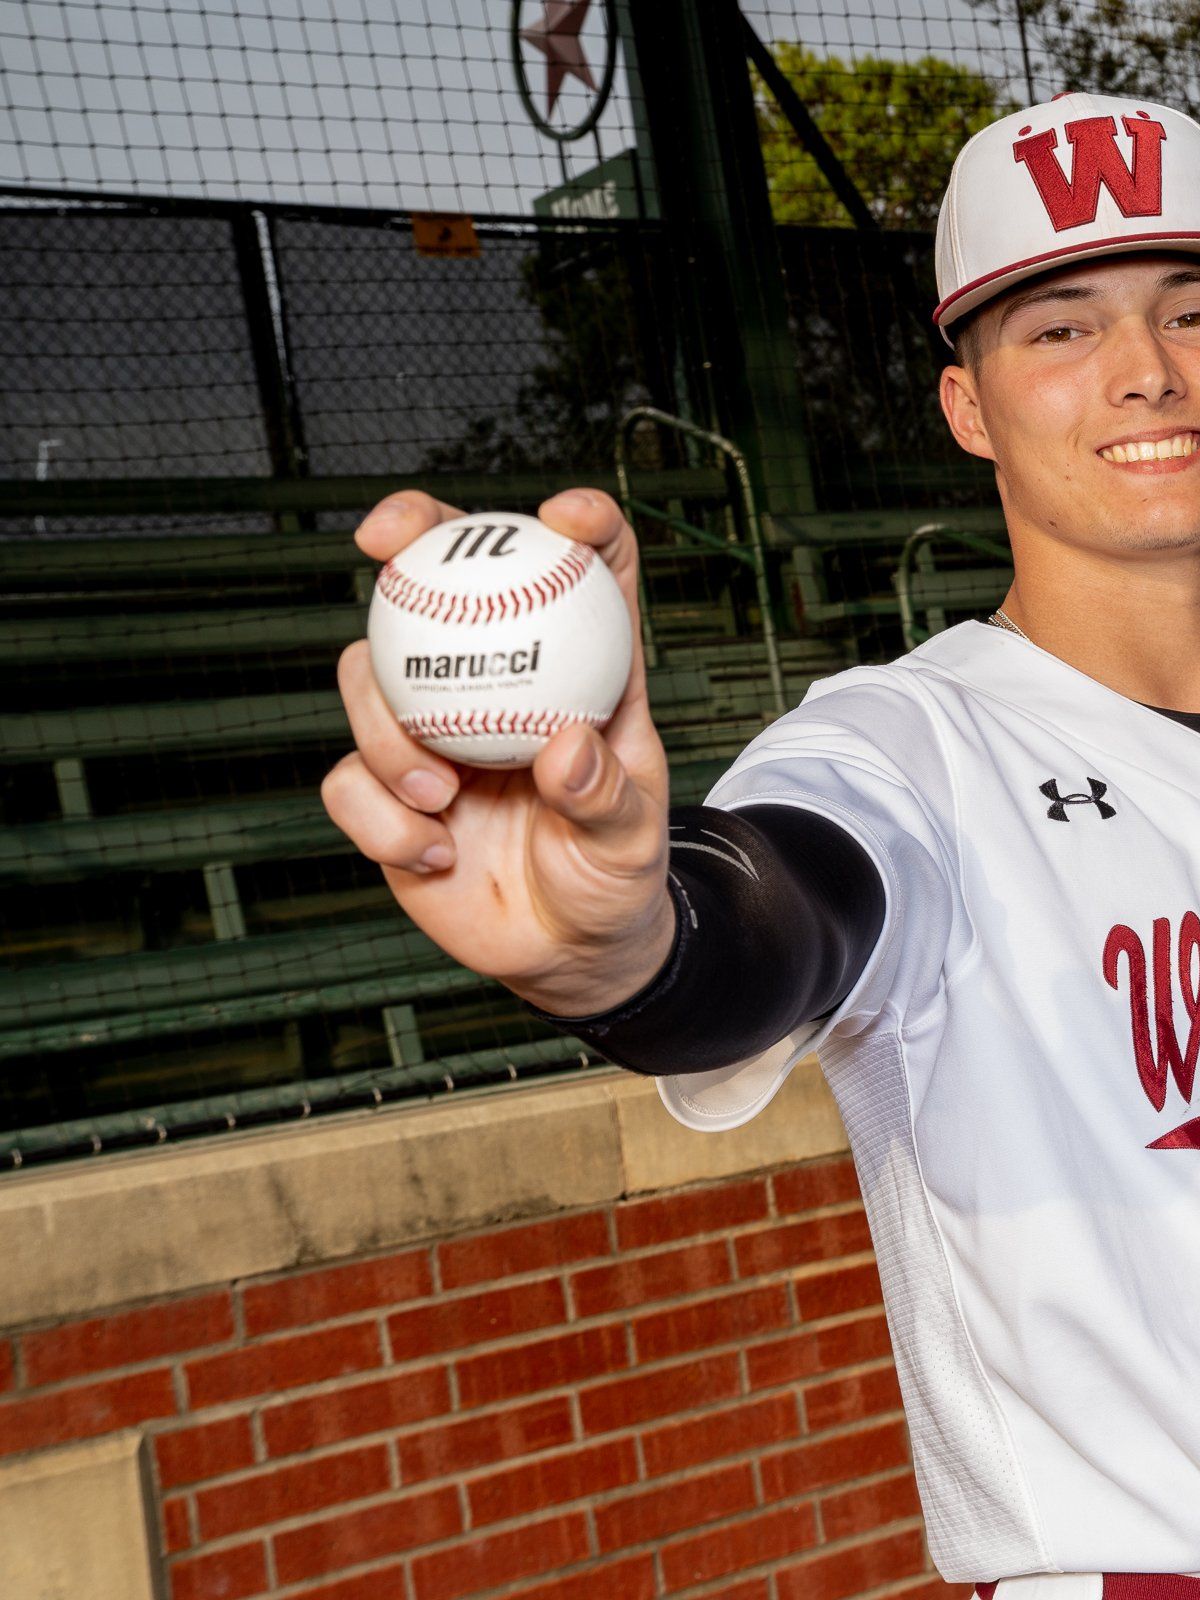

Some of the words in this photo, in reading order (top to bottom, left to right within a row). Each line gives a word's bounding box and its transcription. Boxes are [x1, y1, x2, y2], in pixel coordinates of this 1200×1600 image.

[1012, 115, 1168, 234] W
[441, 525, 519, 564] m
[405, 640, 541, 679] marucci
